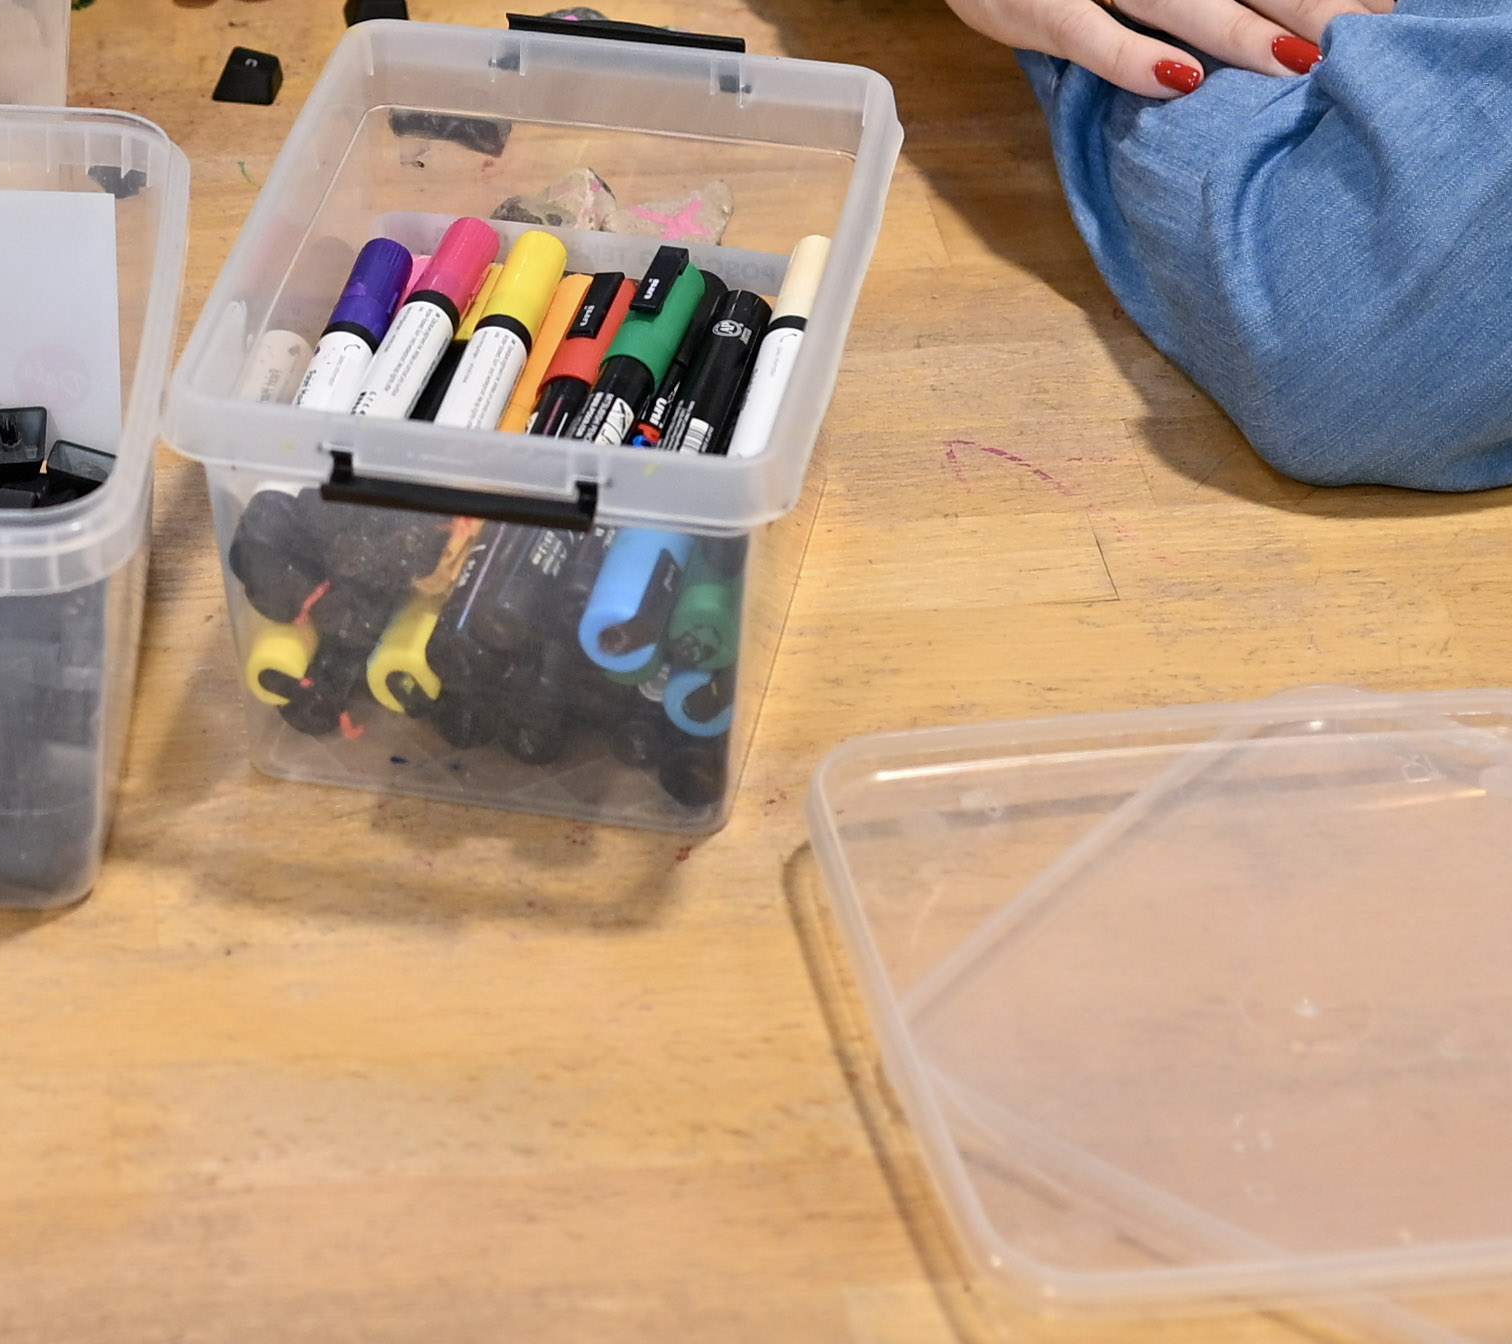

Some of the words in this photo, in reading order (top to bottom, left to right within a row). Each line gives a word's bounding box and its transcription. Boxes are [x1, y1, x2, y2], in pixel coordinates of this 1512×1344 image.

[643, 277, 660, 300] uni
[579, 304, 595, 327] uni
[649, 397, 668, 429] uni
